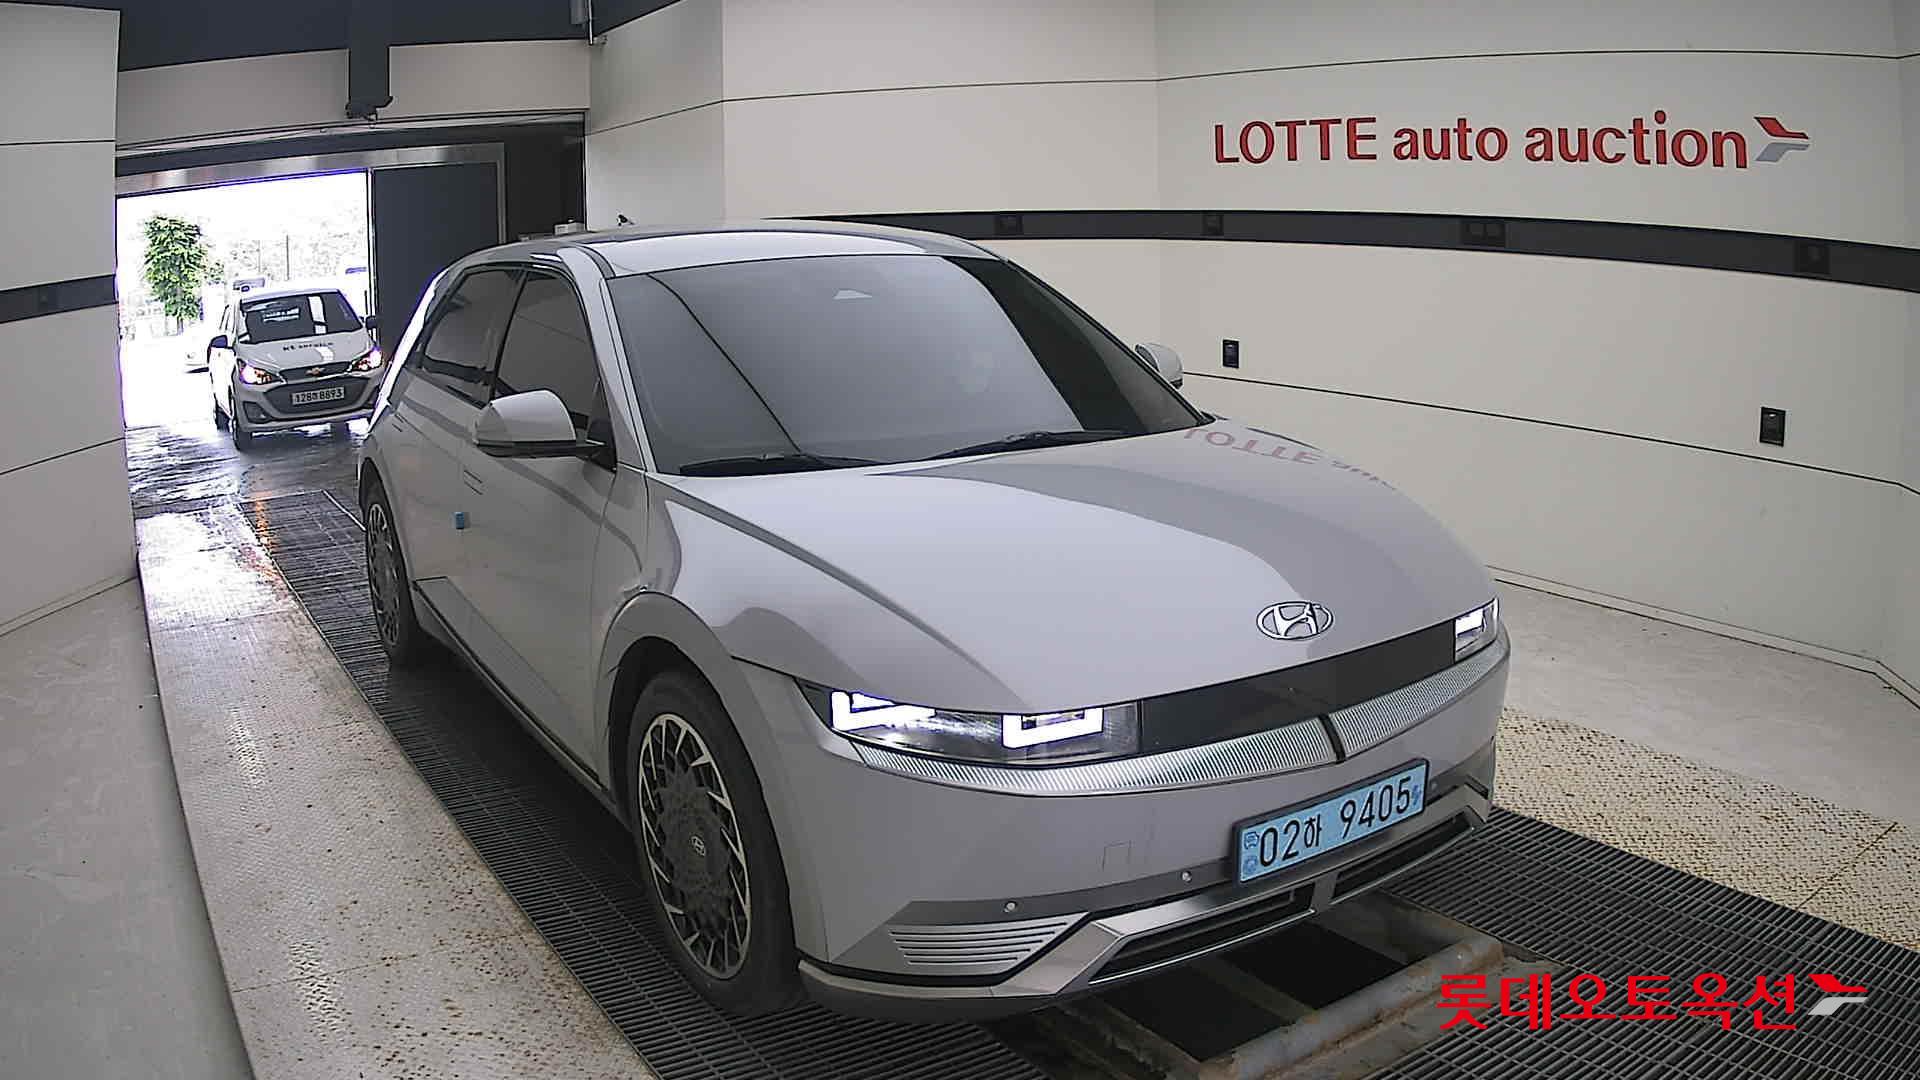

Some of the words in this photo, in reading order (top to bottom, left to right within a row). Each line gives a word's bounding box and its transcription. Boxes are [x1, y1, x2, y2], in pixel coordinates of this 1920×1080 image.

[1214, 116, 1377, 164] LOTTE
[1393, 117, 1509, 163] auto
[1525, 110, 1748, 169] auction
[1259, 814, 1322, 867] 02하
[1340, 776, 1412, 839] 9405
